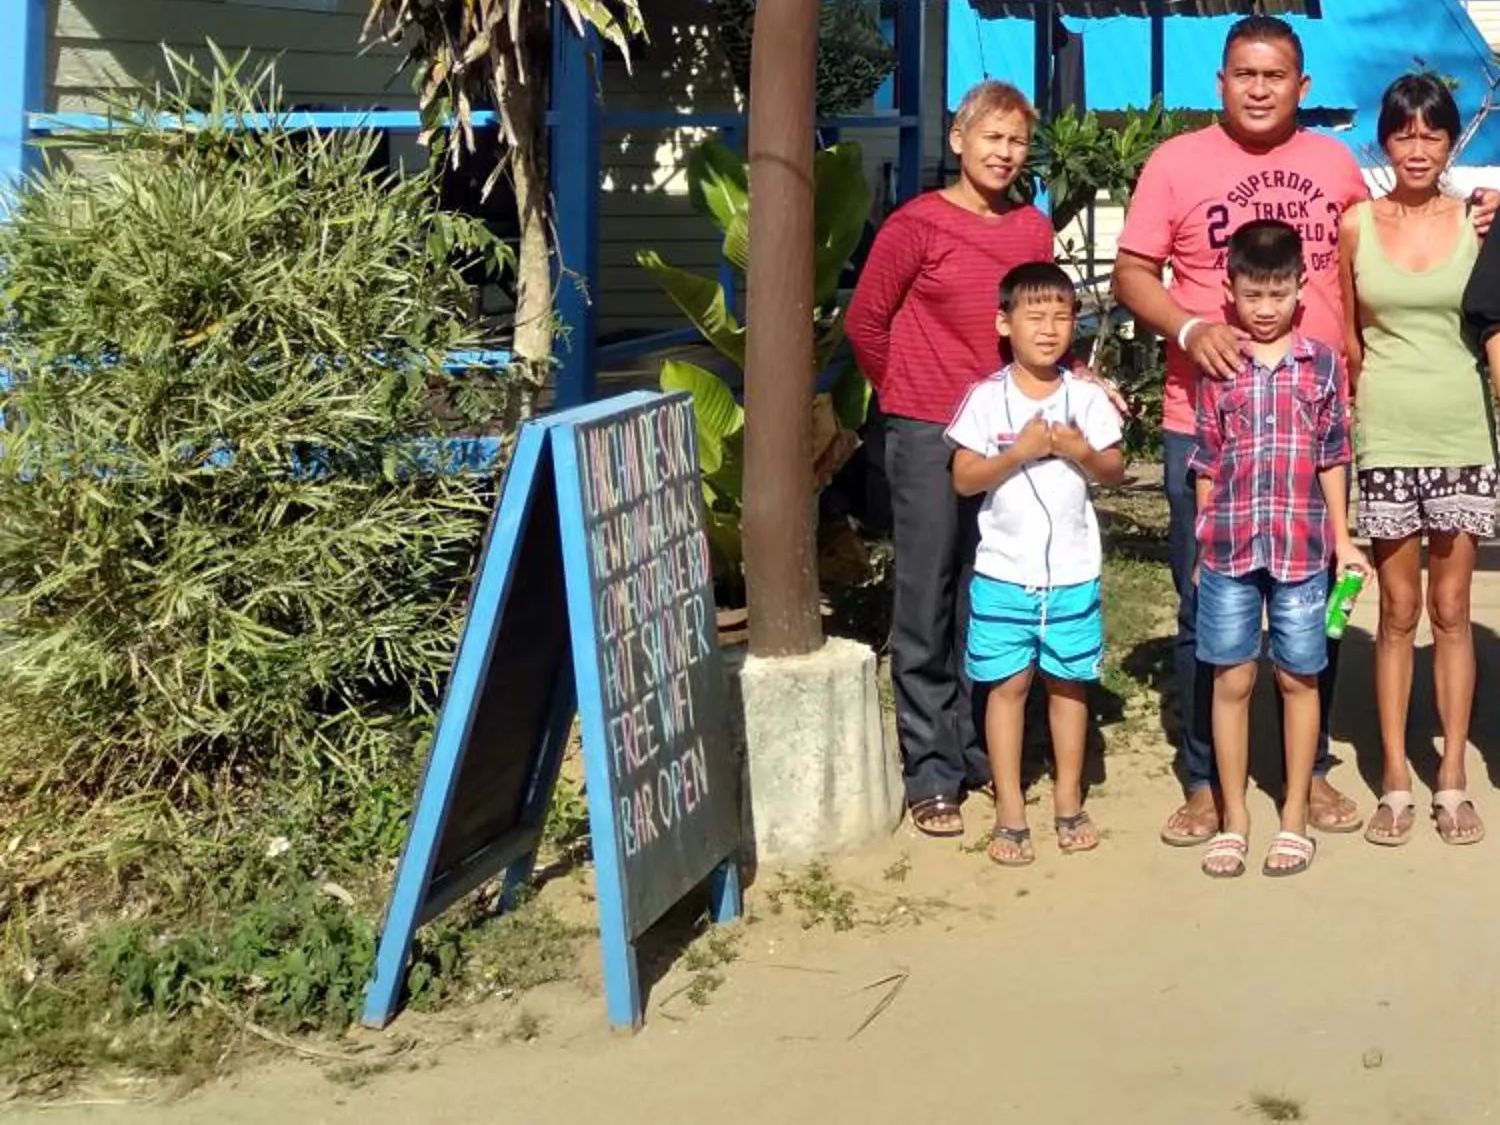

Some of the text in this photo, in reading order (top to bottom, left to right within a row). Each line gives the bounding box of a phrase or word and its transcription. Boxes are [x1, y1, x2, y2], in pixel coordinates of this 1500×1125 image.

[1206, 204, 1230, 249] 2
[1227, 170, 1324, 208] SUPERDRY
[1252, 200, 1309, 220] TRACK
[638, 395, 694, 495] RESORT
[591, 479, 698, 579] NEW BUNGALOWS
[600, 539, 690, 638] COMFORTABLE
[603, 593, 711, 710] HOT SHOWER
[610, 669, 696, 778] FREE WIFI
[620, 735, 709, 859] BAR OPEN
